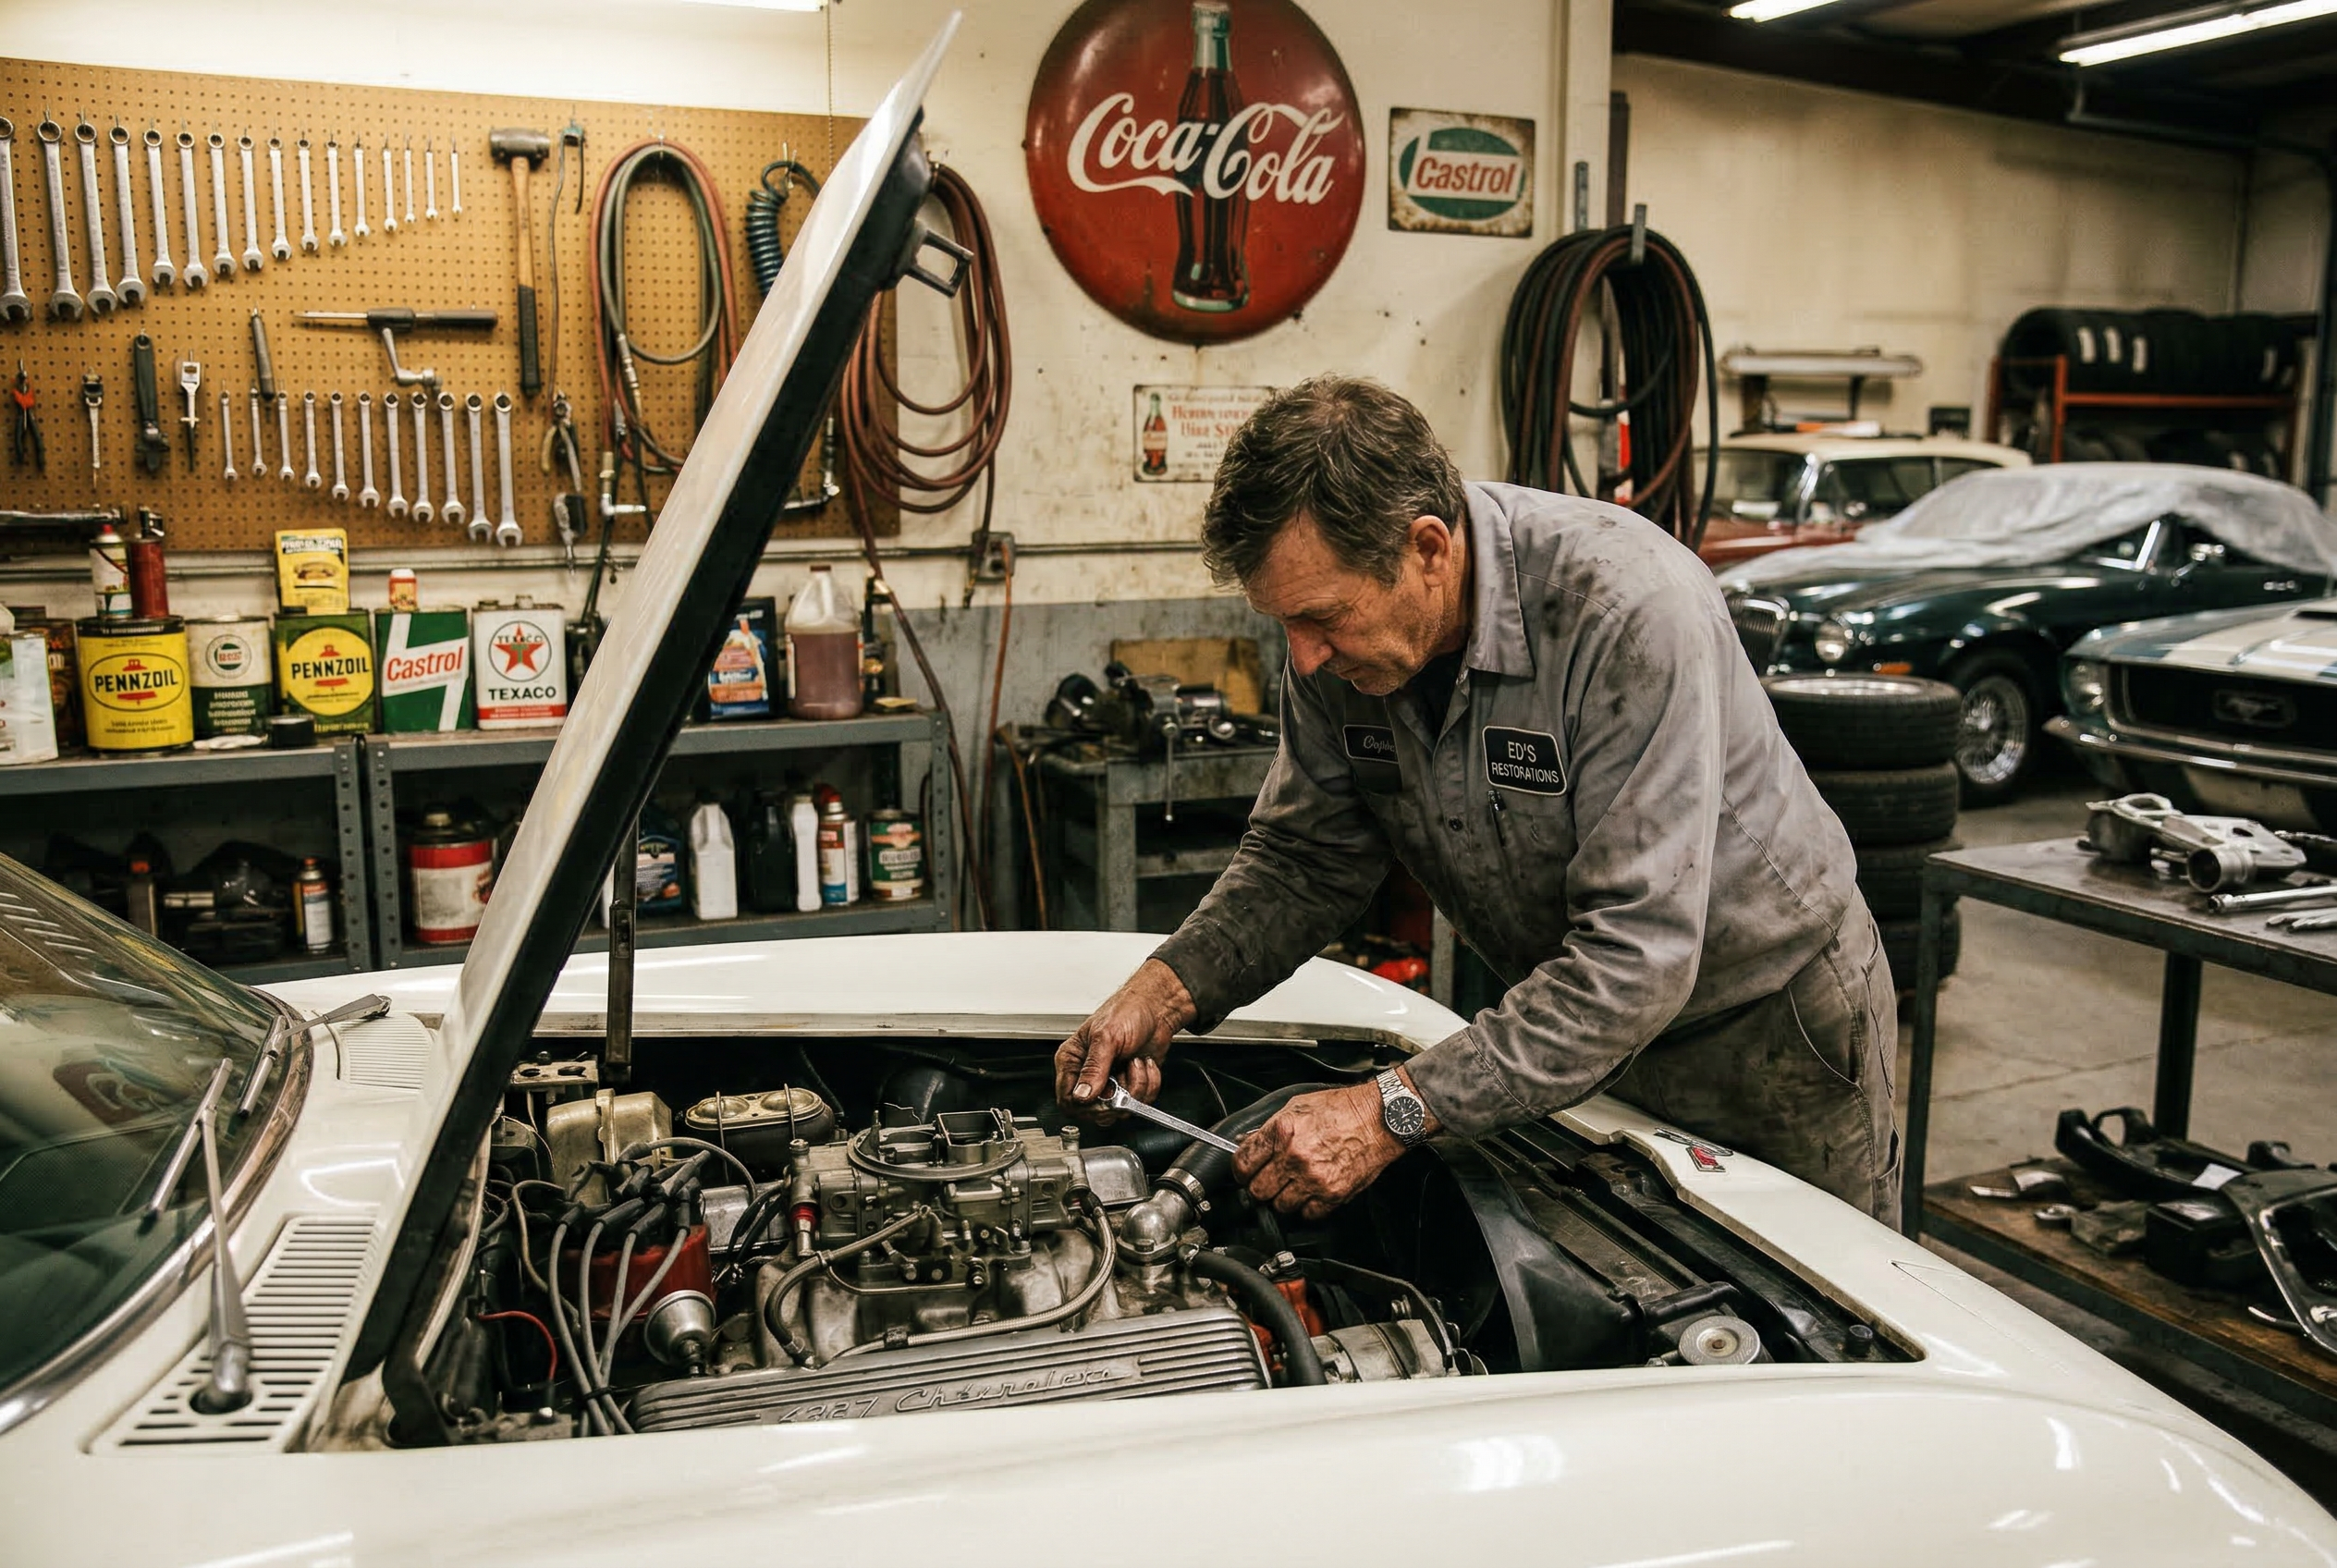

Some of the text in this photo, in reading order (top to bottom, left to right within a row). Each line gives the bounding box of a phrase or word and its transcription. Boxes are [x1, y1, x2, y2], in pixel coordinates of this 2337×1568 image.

[1067, 92, 1344, 204] Coca-Cola
[1415, 155, 1518, 194] Castrol
[291, 655, 370, 680] PENNZOIL
[386, 645, 464, 682] Castrol
[94, 668, 178, 692] PENNZOIL
[488, 685, 557, 701] TEXACO
[1508, 741, 1536, 763] ED'S
[1491, 762, 1560, 783] RESTORATIONS
